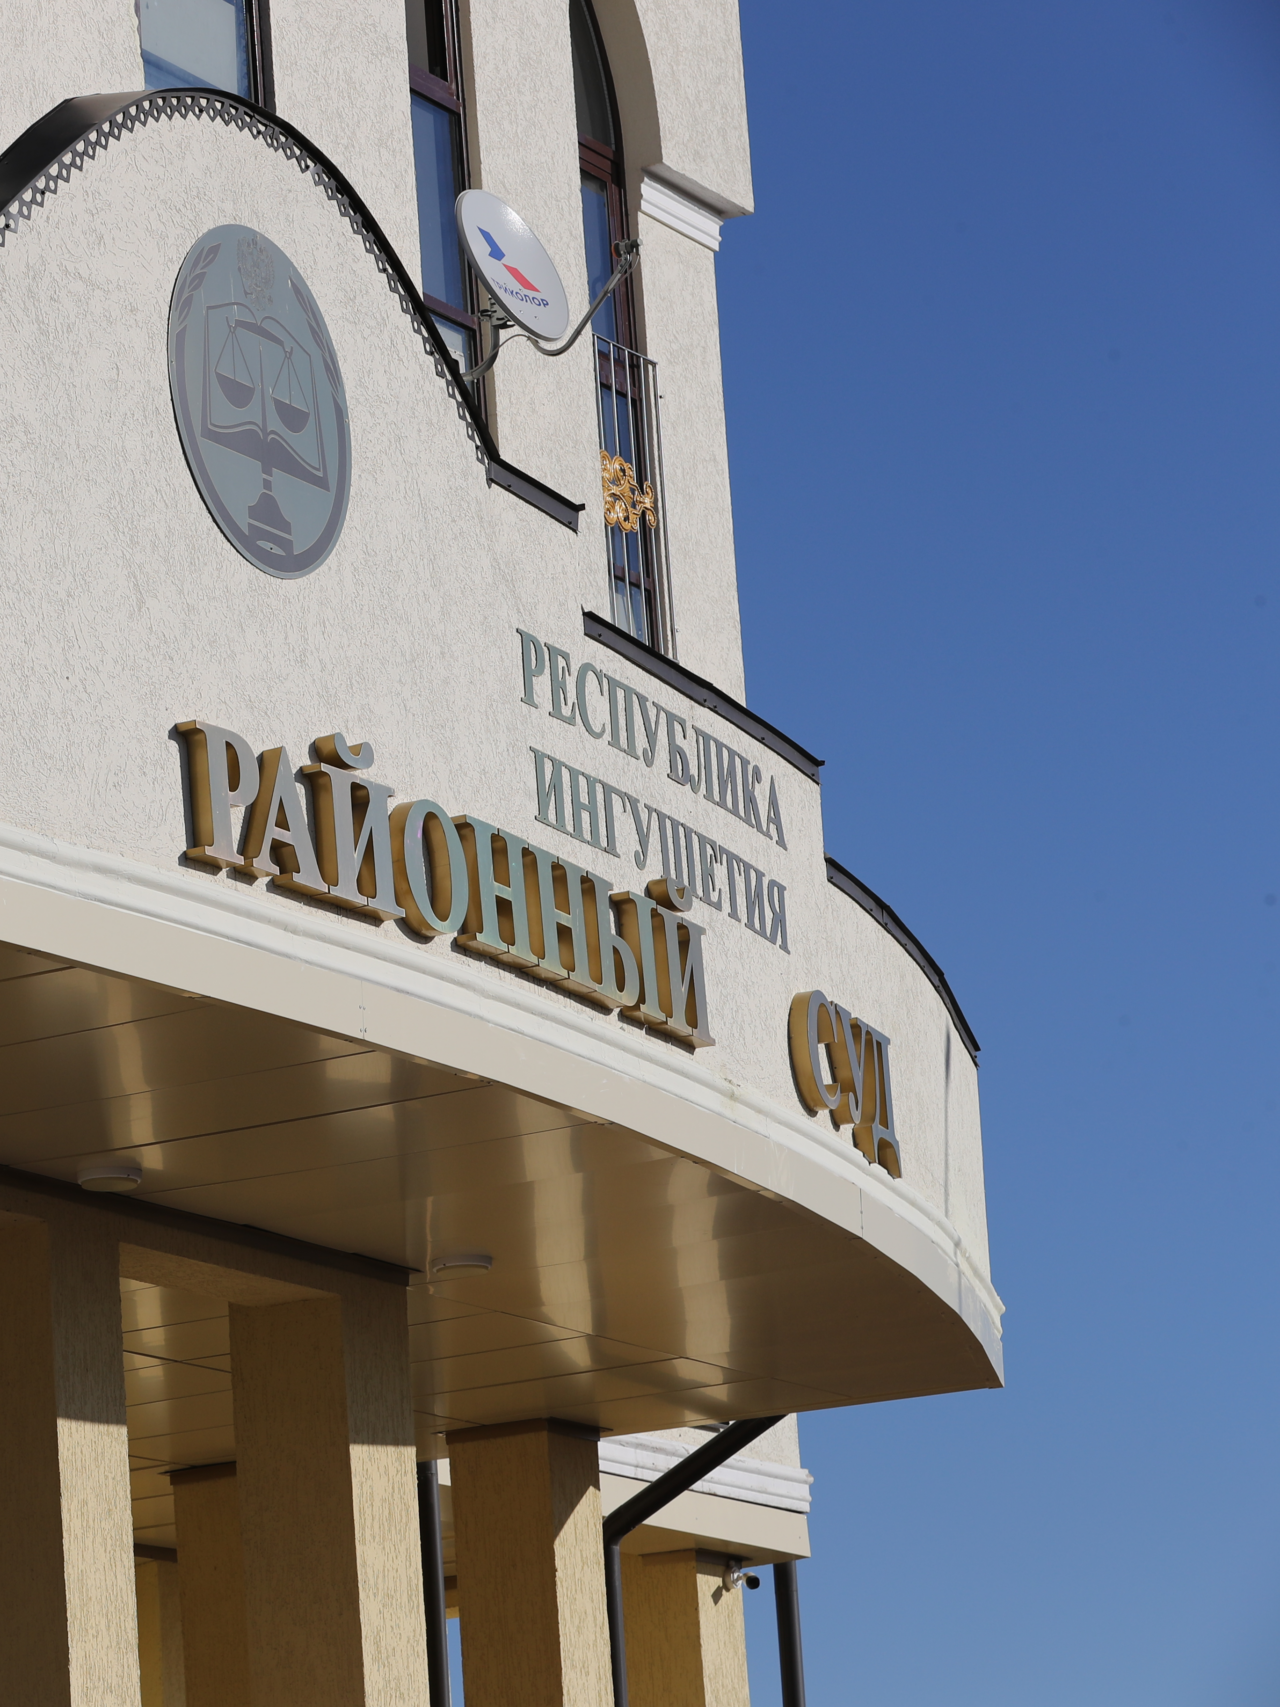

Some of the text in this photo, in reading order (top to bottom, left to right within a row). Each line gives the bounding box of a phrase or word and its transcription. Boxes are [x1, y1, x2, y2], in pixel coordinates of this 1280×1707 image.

[490, 277, 549, 308] ТРИКОЛОР
[516, 627, 788, 851] РЕСПУБЛИКА
[176, 720, 715, 1049] РАЙОННЫЙ
[789, 990, 902, 1179] СУД
[529, 746, 791, 955] ИНГУШЕТИЯ
